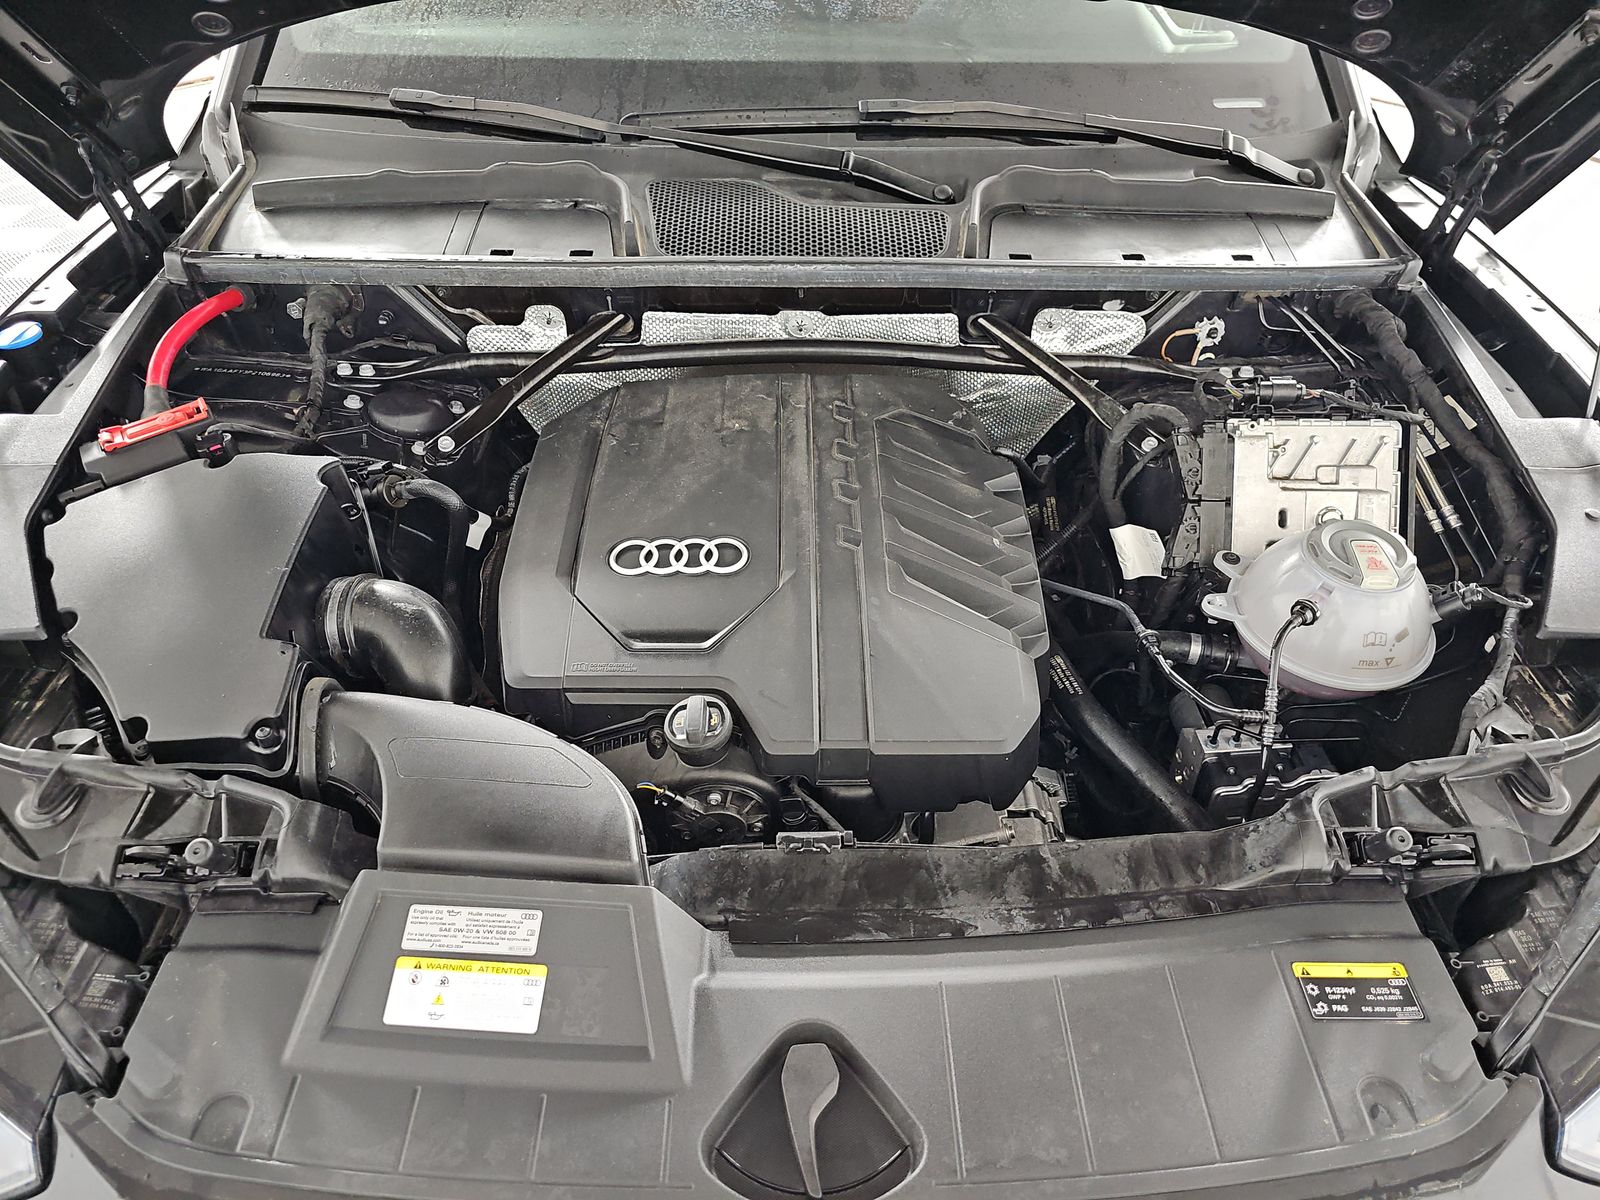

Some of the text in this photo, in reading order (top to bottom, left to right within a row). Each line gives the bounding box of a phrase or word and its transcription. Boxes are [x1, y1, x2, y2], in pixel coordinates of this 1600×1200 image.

[1358, 659, 1380, 667] max
[426, 962, 531, 976] WARNING ATTENTION
[1324, 986, 1356, 996] R-1234yf
[1390, 987, 1401, 995] kg
[1331, 1004, 1350, 1012] PAG
